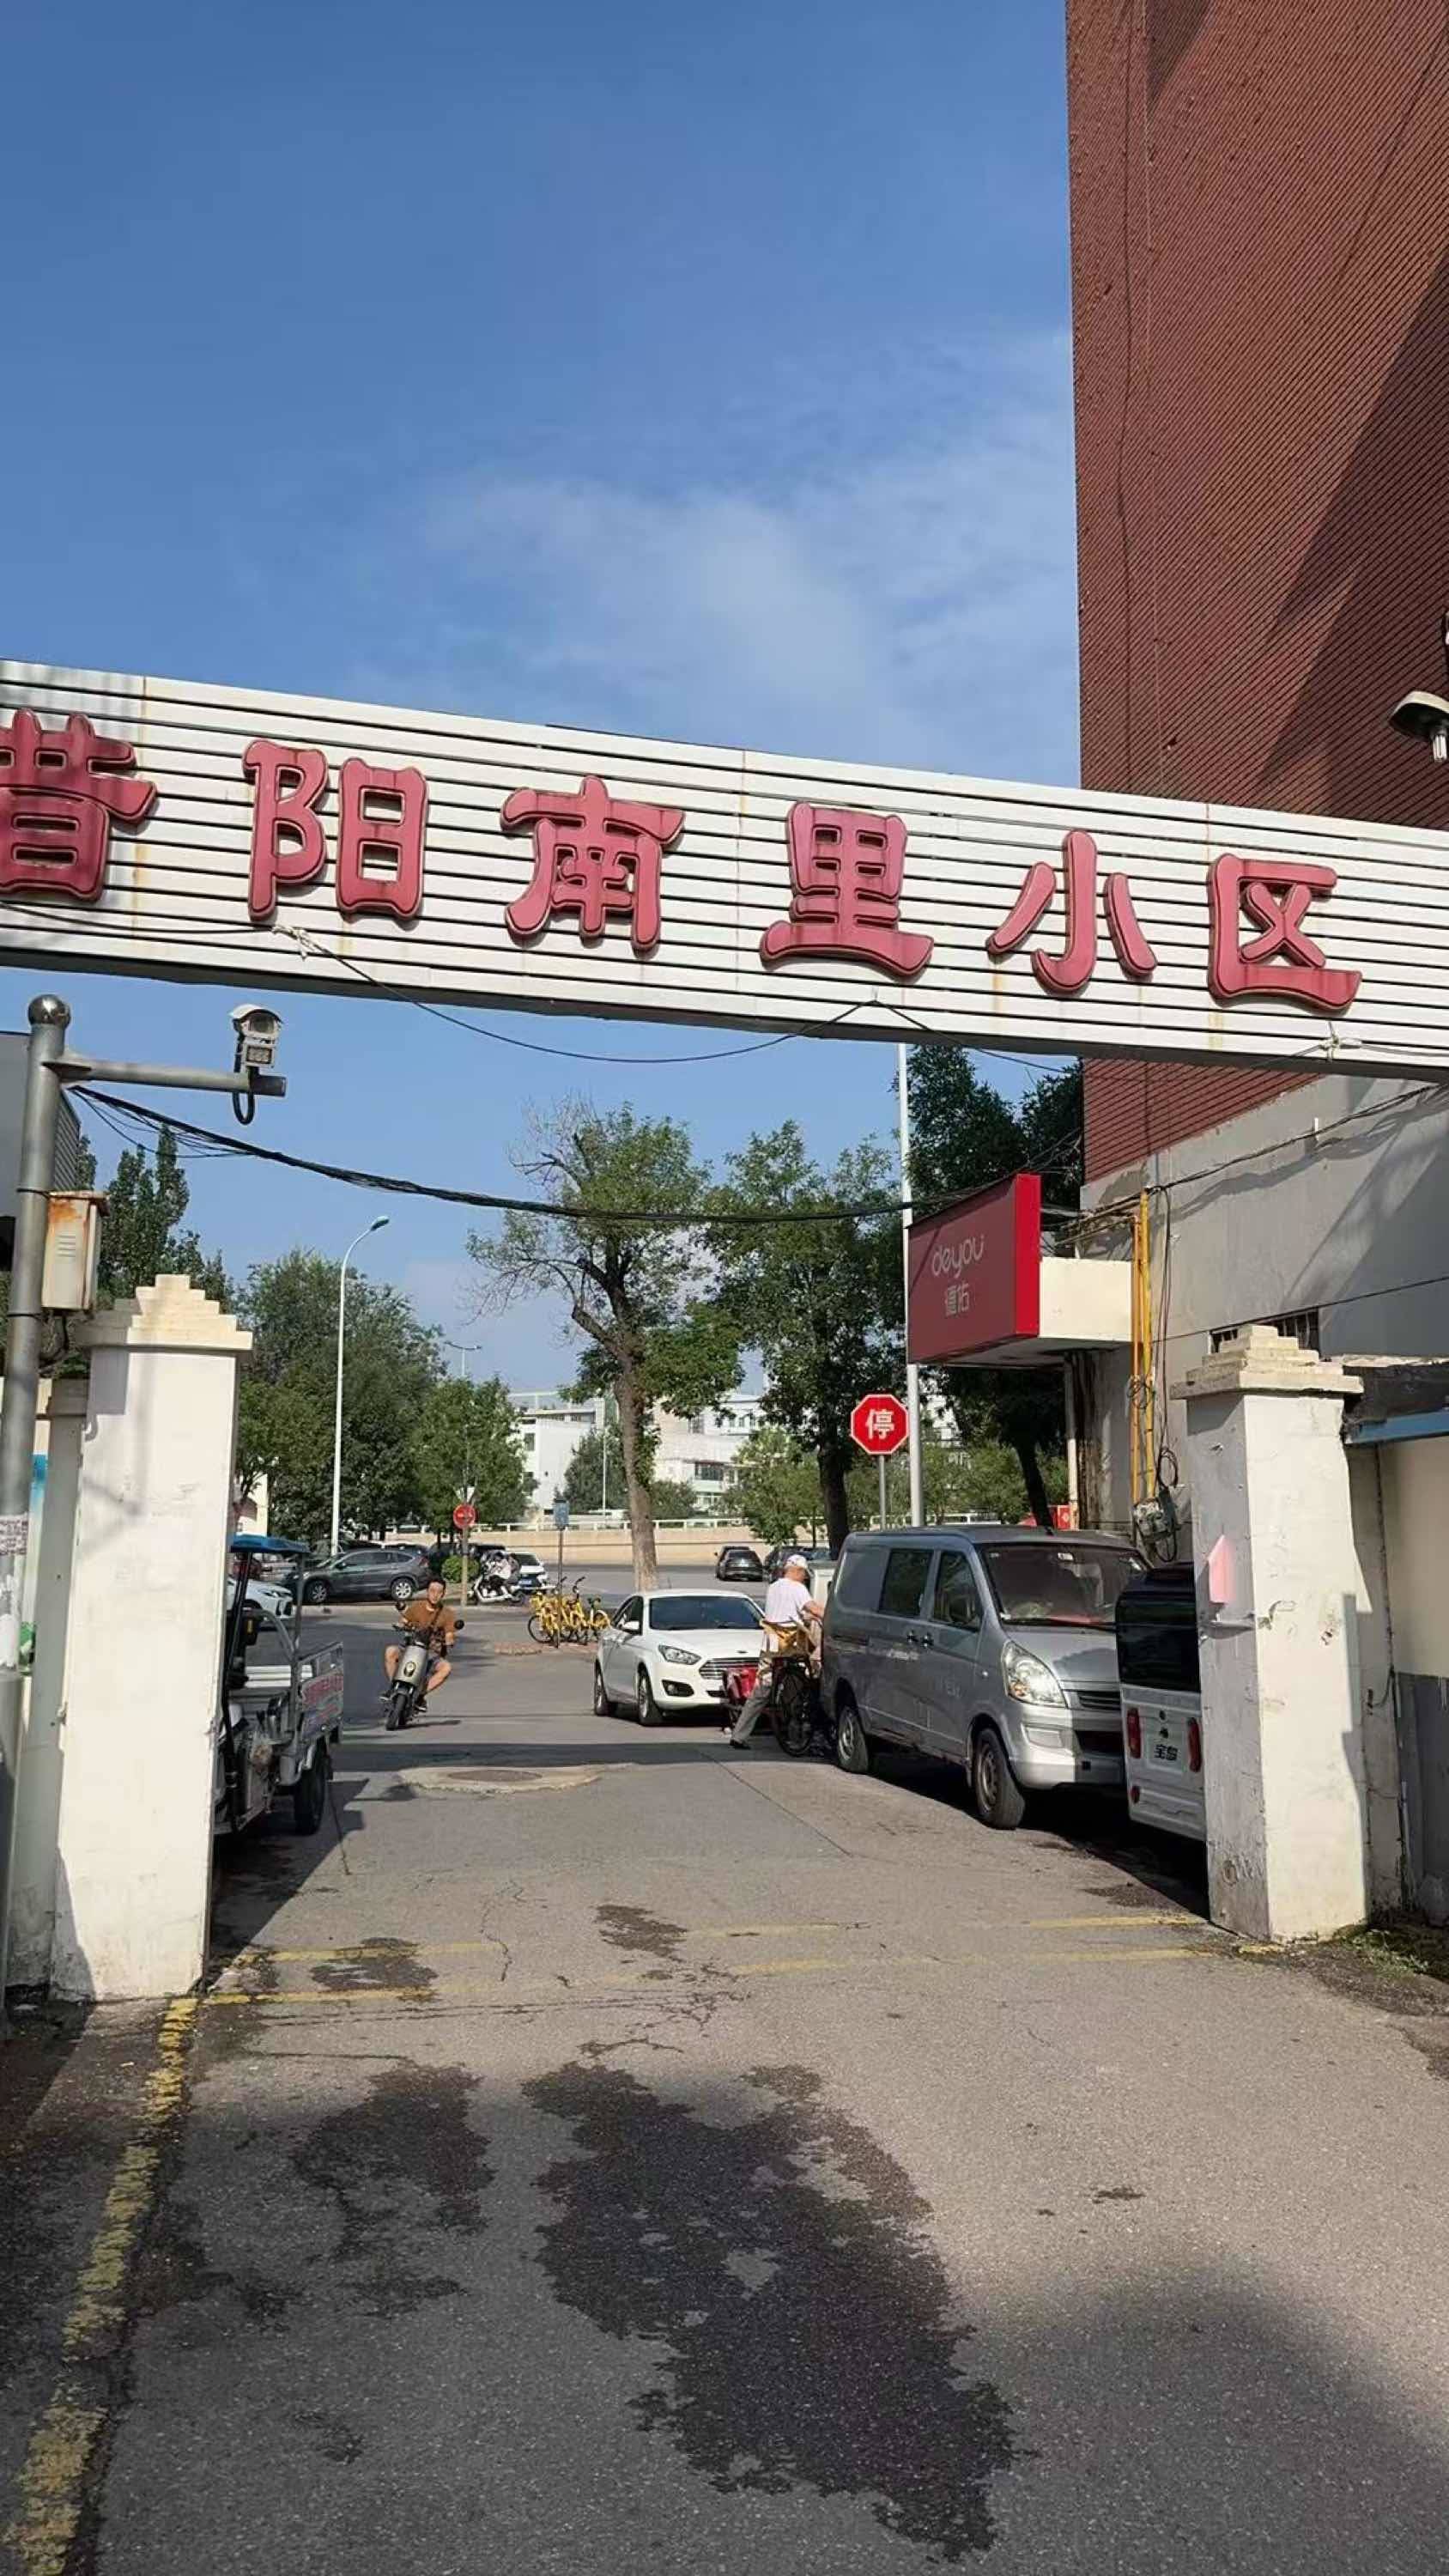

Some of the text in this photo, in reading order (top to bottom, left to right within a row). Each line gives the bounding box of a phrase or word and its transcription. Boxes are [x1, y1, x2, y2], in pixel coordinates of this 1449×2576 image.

[0, 708, 1363, 1012] 昔阳南里小区
[931, 1234, 984, 1278] deyou
[865, 1408, 894, 1440] 停
